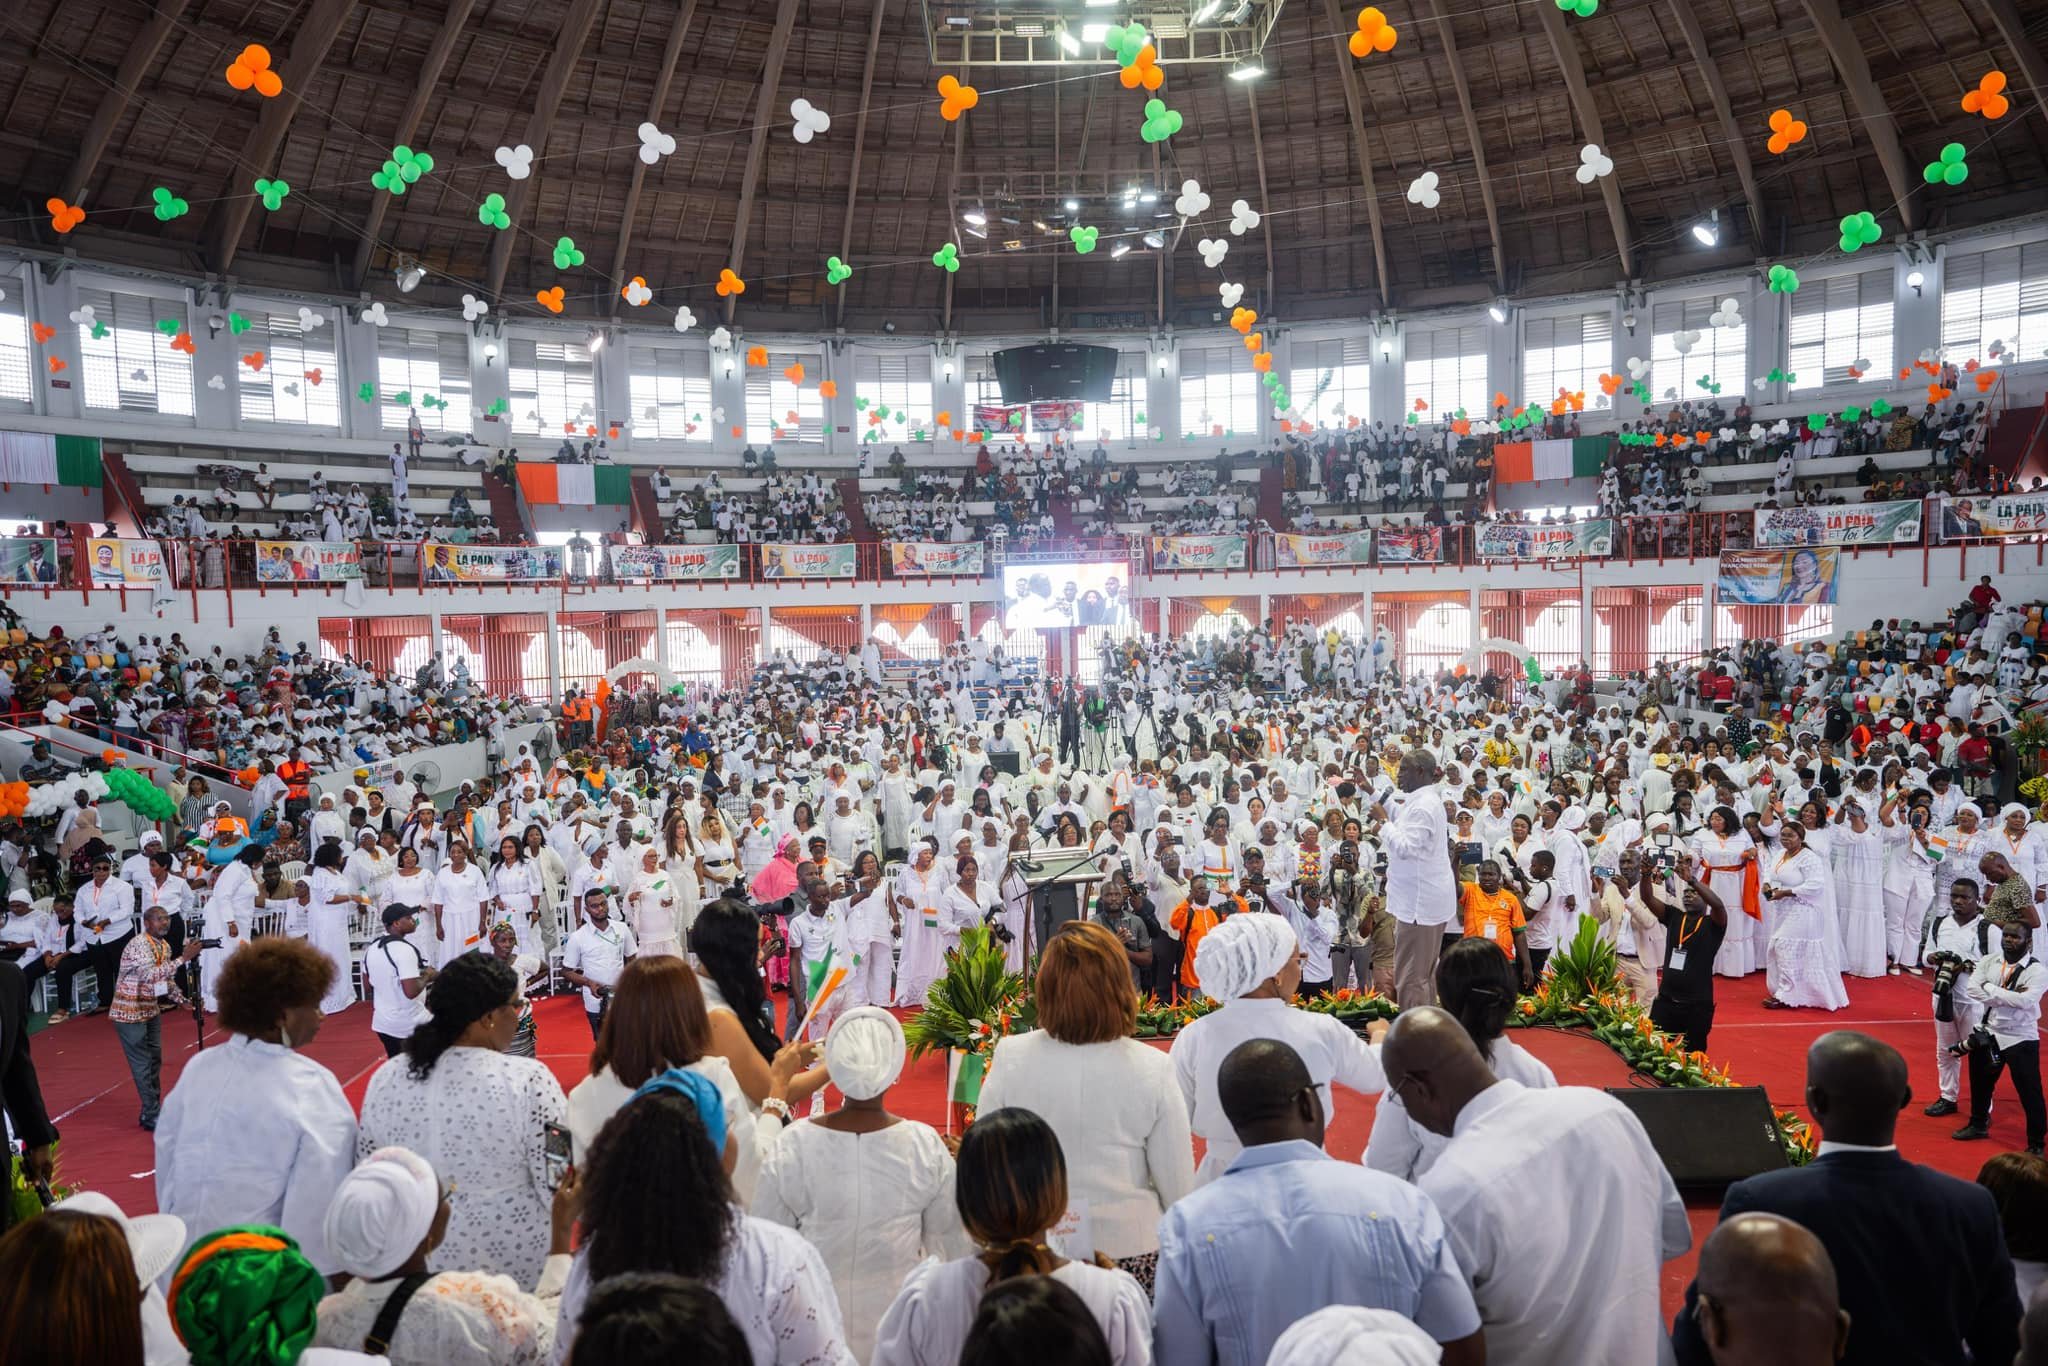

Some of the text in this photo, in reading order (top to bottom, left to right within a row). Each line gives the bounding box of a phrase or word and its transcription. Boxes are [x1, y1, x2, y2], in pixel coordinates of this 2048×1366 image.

[1998, 505, 2012, 517] LA
[2016, 503, 2046, 517] PAIX
[1827, 514, 1874, 529] LA PAIX
[2000, 519, 2011, 527] ET
[2012, 515, 2029, 530] Toi
[1534, 531, 1574, 543] LA PAIX
[1829, 525, 1875, 541] ET Toi ?
[1181, 546, 1191, 555] LA
[1308, 542, 1320, 552] LA
[131, 552, 146, 564] LA
[321, 552, 334, 564] LA
[457, 555, 494, 565] LA PAIX
[670, 554, 705, 565] LA PAIX
[794, 554, 829, 563] LA PAIX
